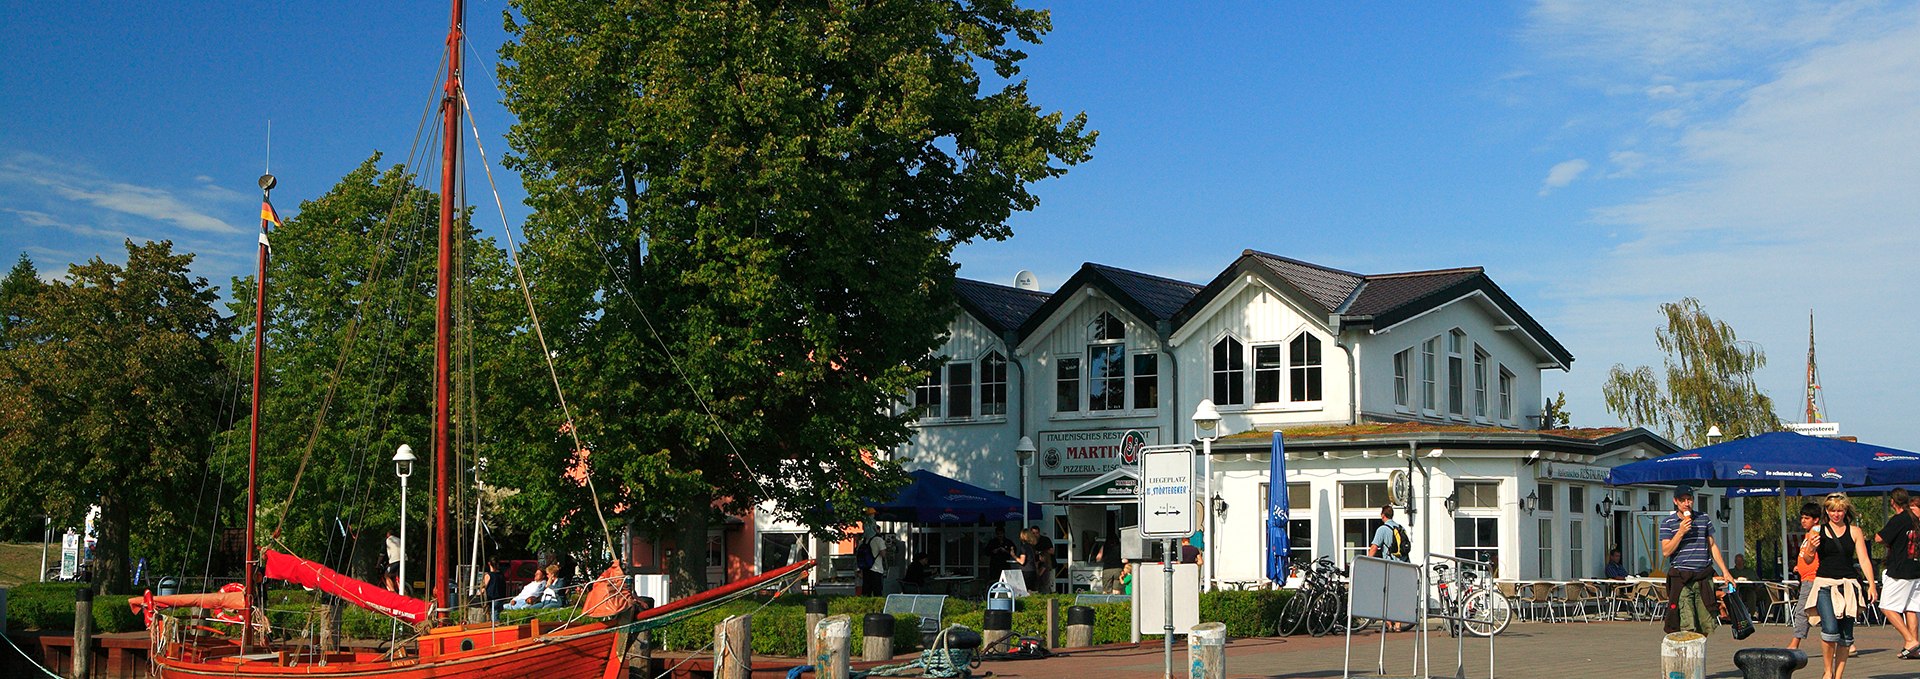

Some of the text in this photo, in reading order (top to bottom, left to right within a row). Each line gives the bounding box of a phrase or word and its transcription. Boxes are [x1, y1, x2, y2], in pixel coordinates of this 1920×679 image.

[1047, 433, 1100, 441] ITALIENISCHES
[1063, 464, 1096, 473] PIZZERIA
[1102, 464, 1120, 472] EISC
